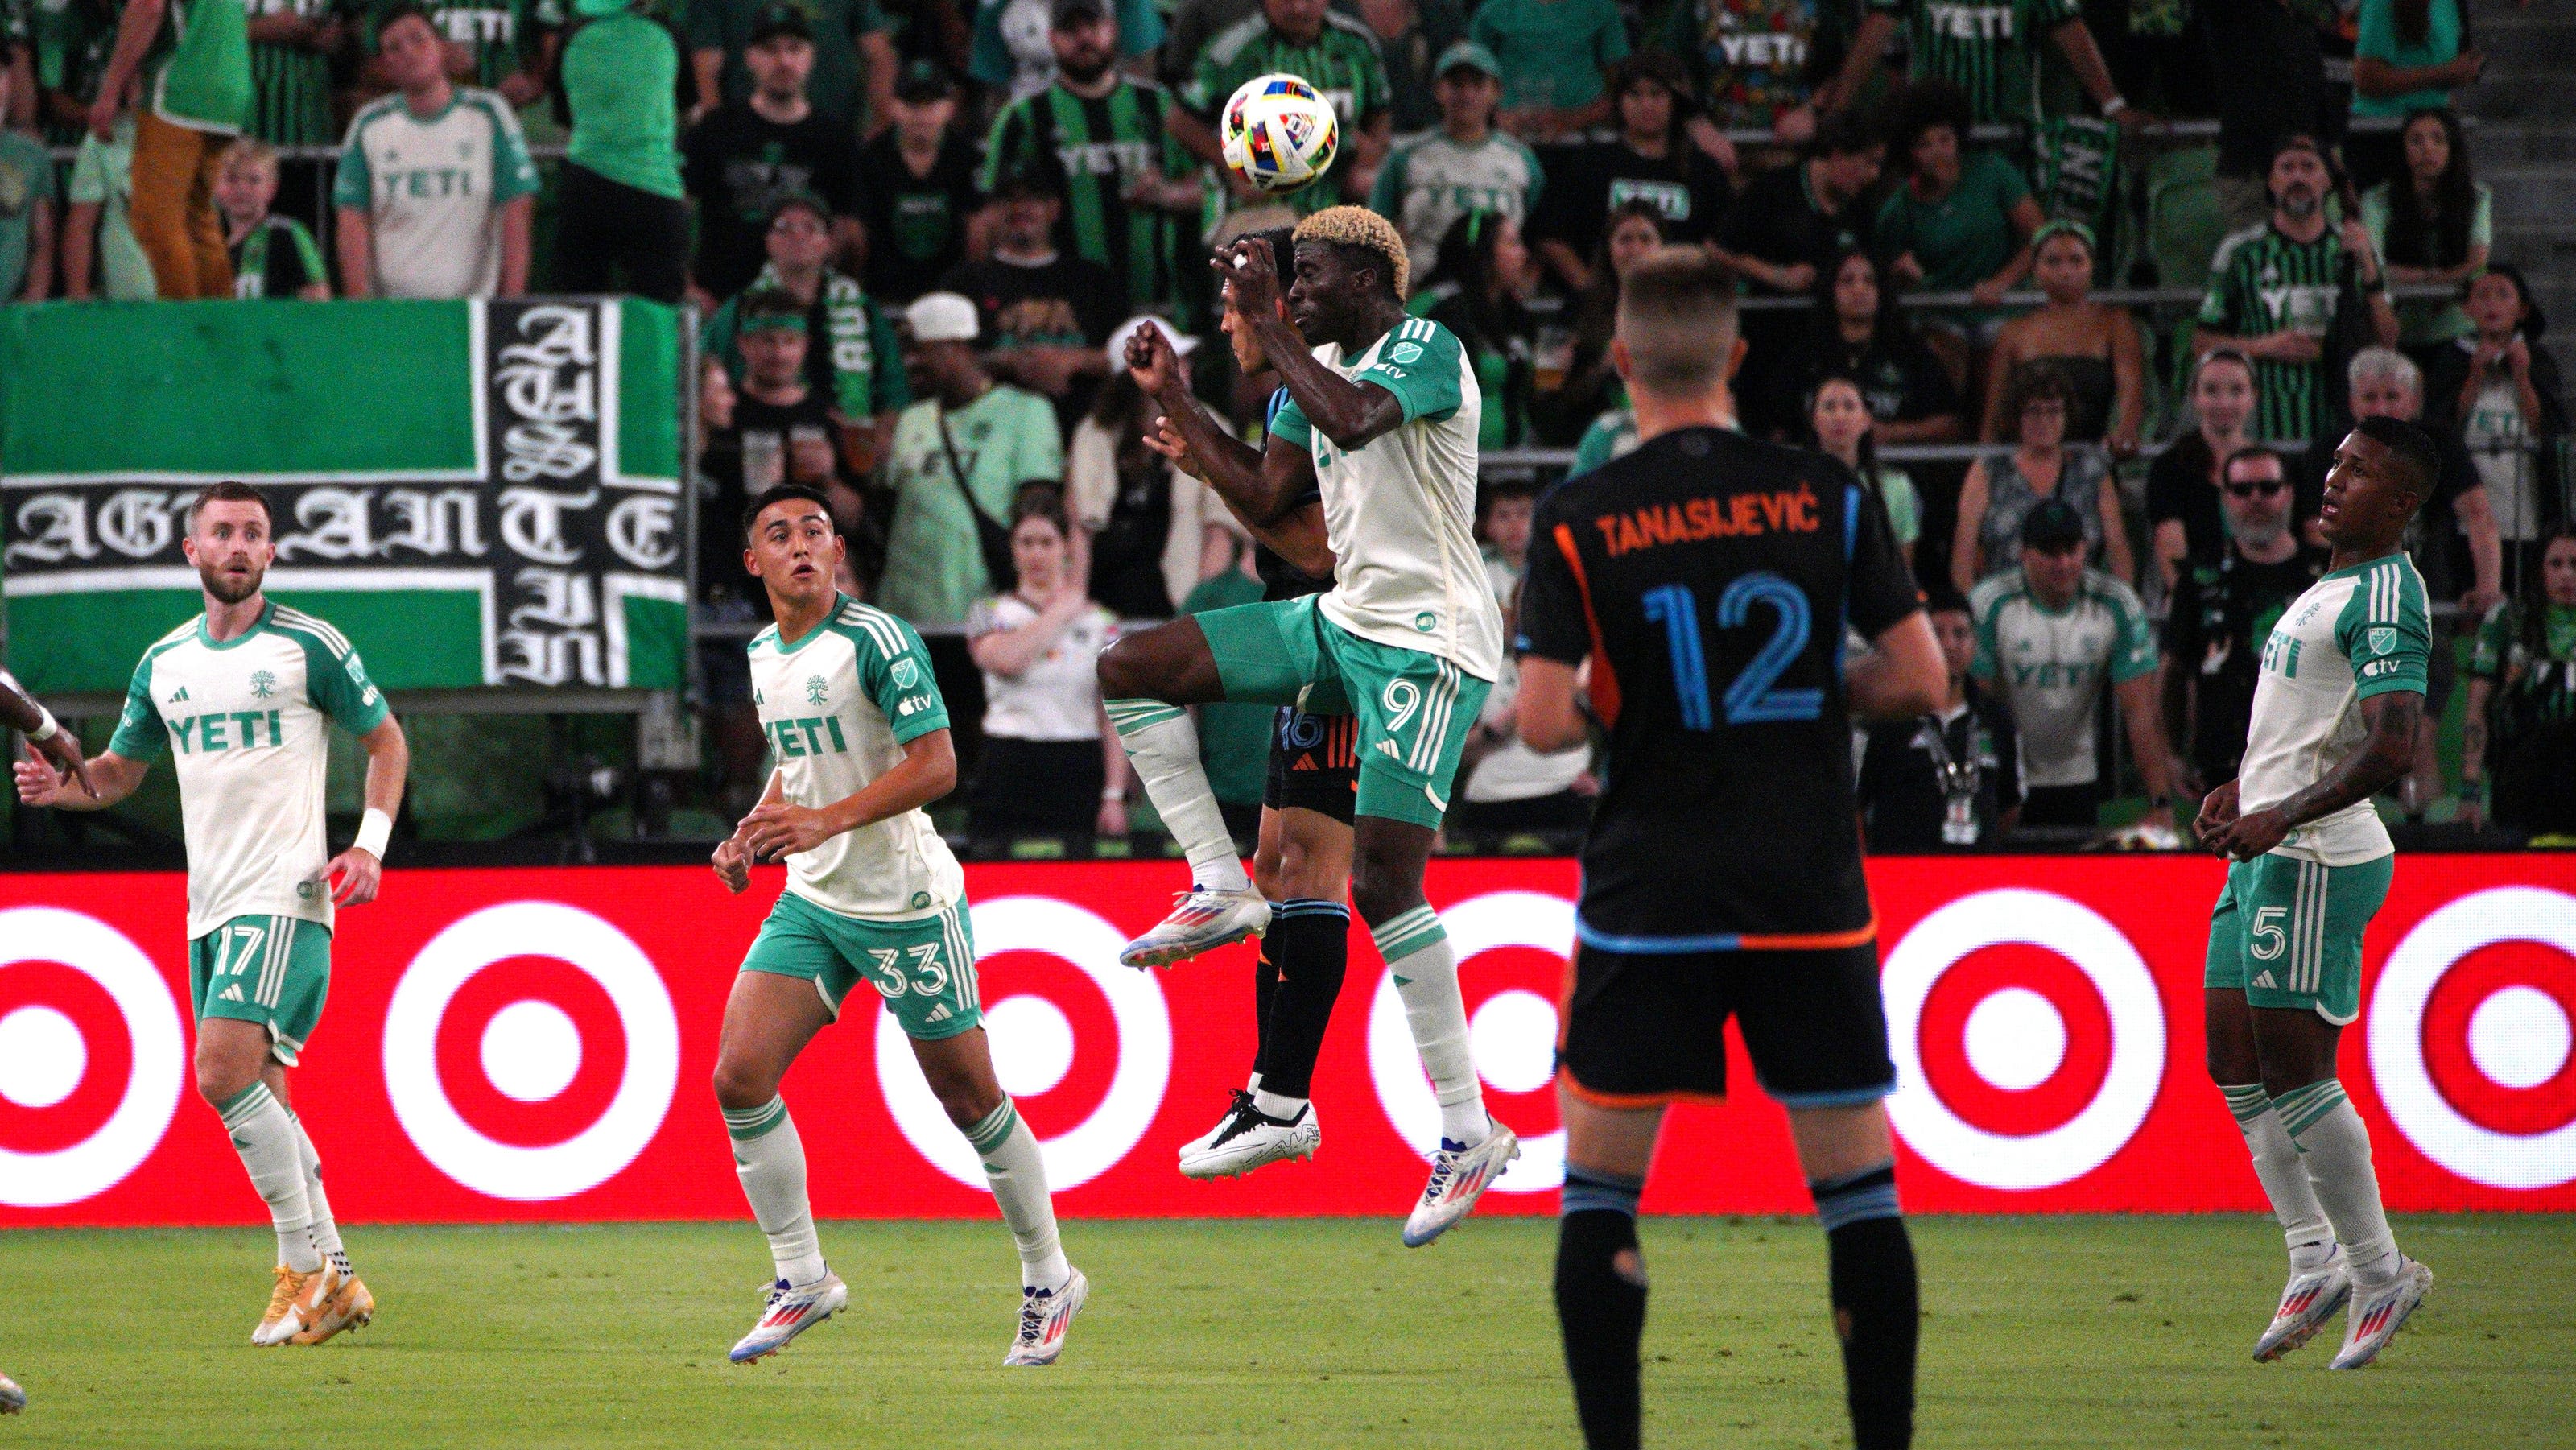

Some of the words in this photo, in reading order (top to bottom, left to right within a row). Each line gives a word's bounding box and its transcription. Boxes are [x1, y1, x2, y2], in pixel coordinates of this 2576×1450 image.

[1926, 4, 2013, 39] YETI
[1719, 34, 1806, 64] YETI
[382, 167, 473, 199] YETI
[2259, 285, 2341, 321] YET
[5, 487, 680, 571] AGANTE
[1596, 481, 1821, 558] TANASIJEVIĆ
[1641, 571, 1825, 732] 12
[2379, 659, 2400, 674] tv
[912, 694, 931, 711] tv
[1383, 678, 1421, 732] 9
[168, 709, 282, 754] YETI
[217, 926, 265, 976] 17
[2251, 907, 2288, 961] 5
[869, 942, 948, 998] 33
